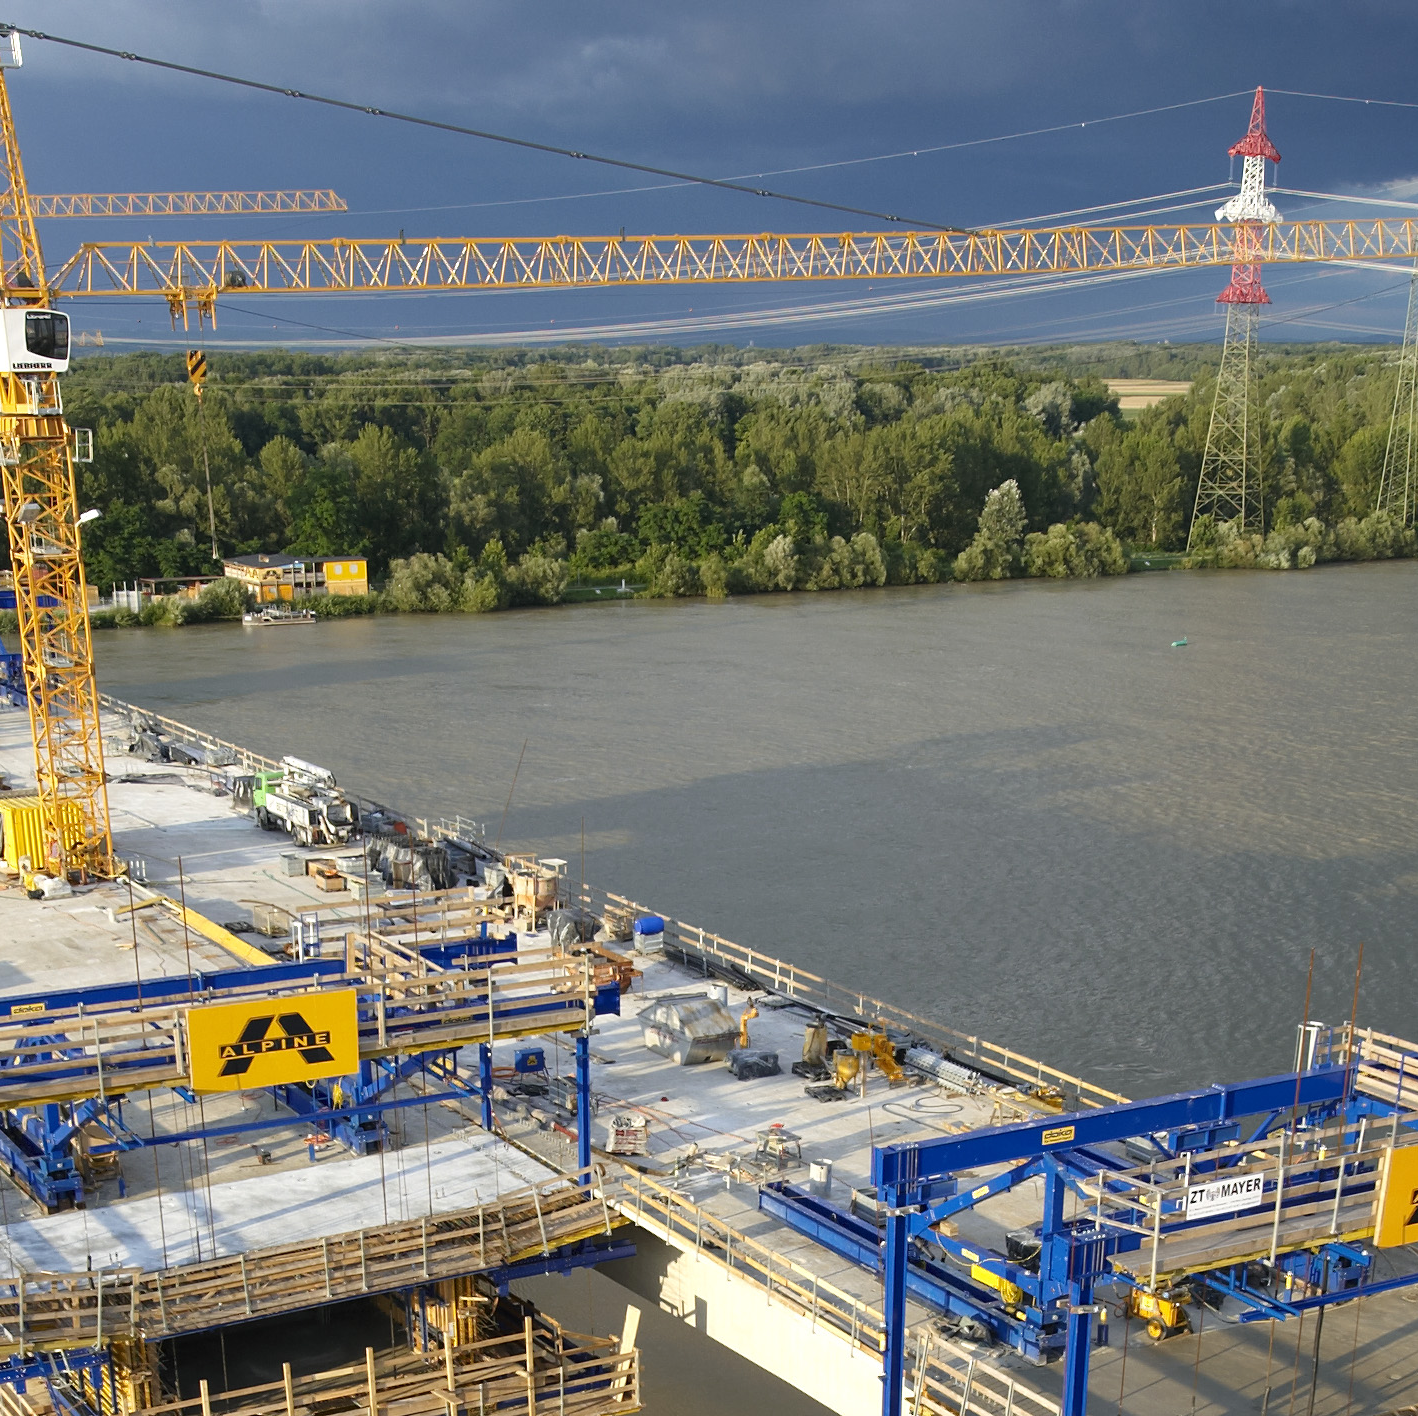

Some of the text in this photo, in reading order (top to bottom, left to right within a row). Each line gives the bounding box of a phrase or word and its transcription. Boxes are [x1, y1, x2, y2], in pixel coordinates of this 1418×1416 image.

[221, 1032, 329, 1058] ALPINE
[1189, 1177, 1261, 1204] ZT MAYER
